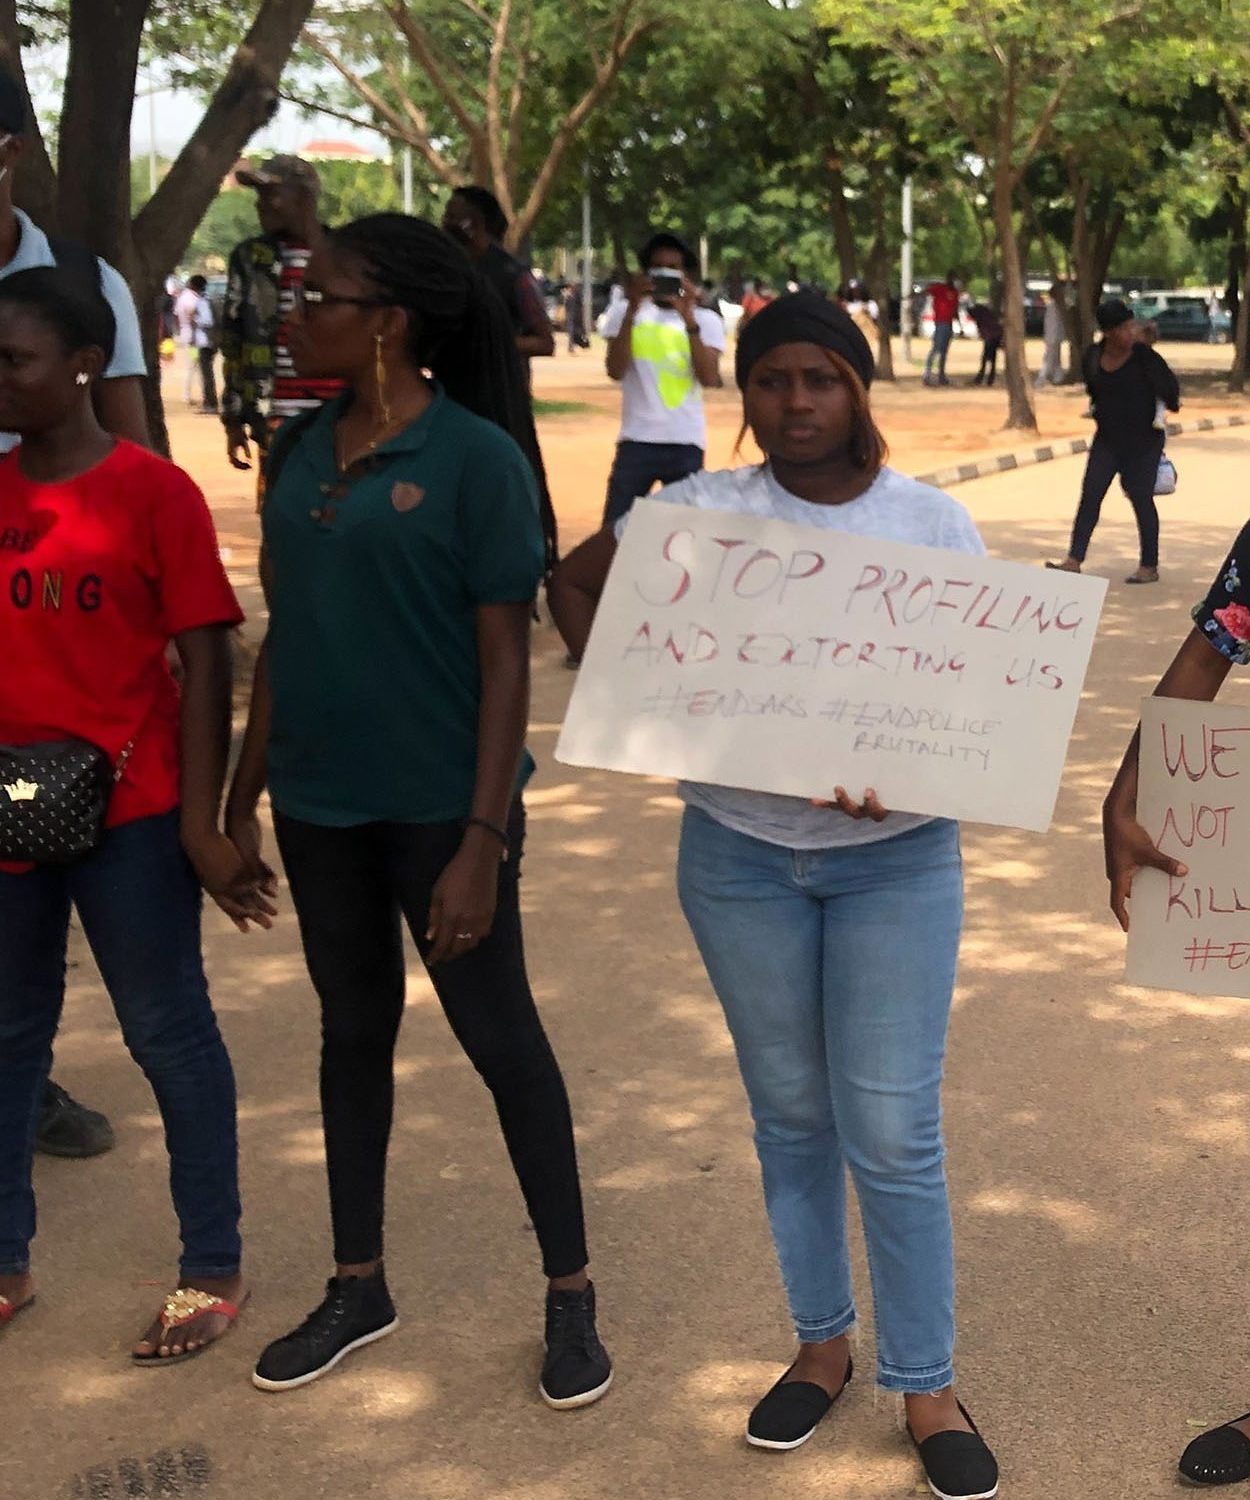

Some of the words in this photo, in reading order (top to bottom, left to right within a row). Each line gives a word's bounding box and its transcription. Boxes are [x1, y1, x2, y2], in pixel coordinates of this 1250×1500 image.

[634, 527, 826, 608] STOP
[844, 563, 1083, 639] PROFILING
[622, 621, 720, 667] AND
[736, 632, 967, 682] EXTORTING
[1005, 657, 1064, 690] US
[818, 697, 1003, 736] #ENDPOLICE
[852, 731, 991, 771] BRUTALITY
[1155, 802, 1236, 850] NOT
